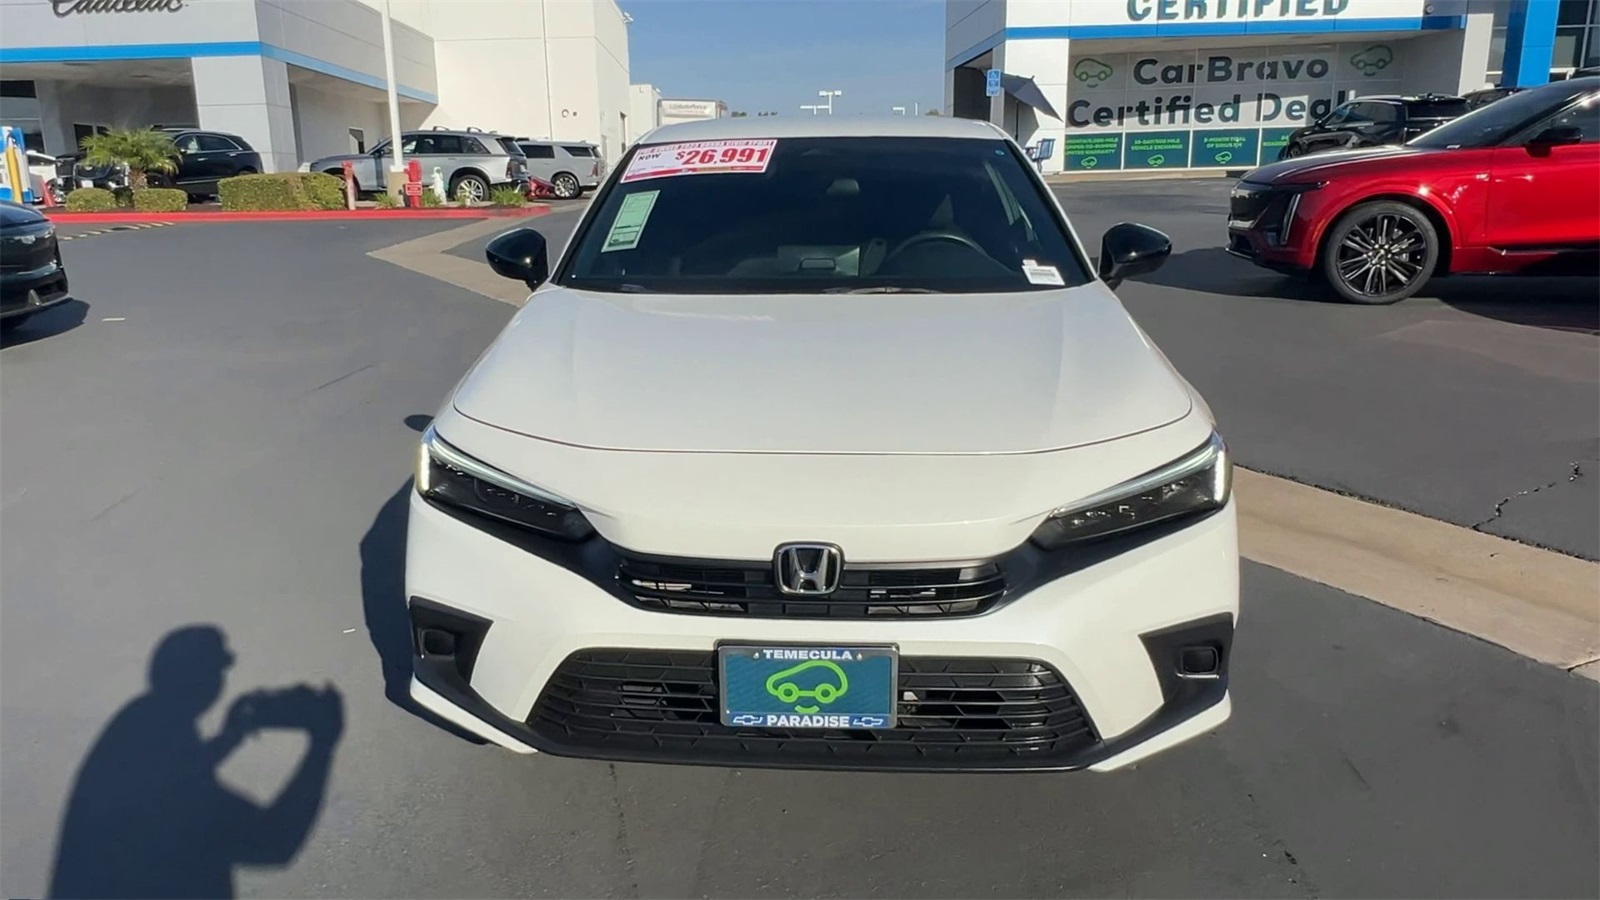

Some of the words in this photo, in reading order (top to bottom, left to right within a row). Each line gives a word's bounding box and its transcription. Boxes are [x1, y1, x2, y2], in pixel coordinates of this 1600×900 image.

[1126, 0, 1350, 21] CERTIFIED
[1132, 55, 1330, 85] CarBravo
[1066, 94, 1242, 128] Certified
[638, 152, 662, 161] NOW
[762, 649, 853, 660] TEMECULA
[766, 714, 851, 728] PARADISE
